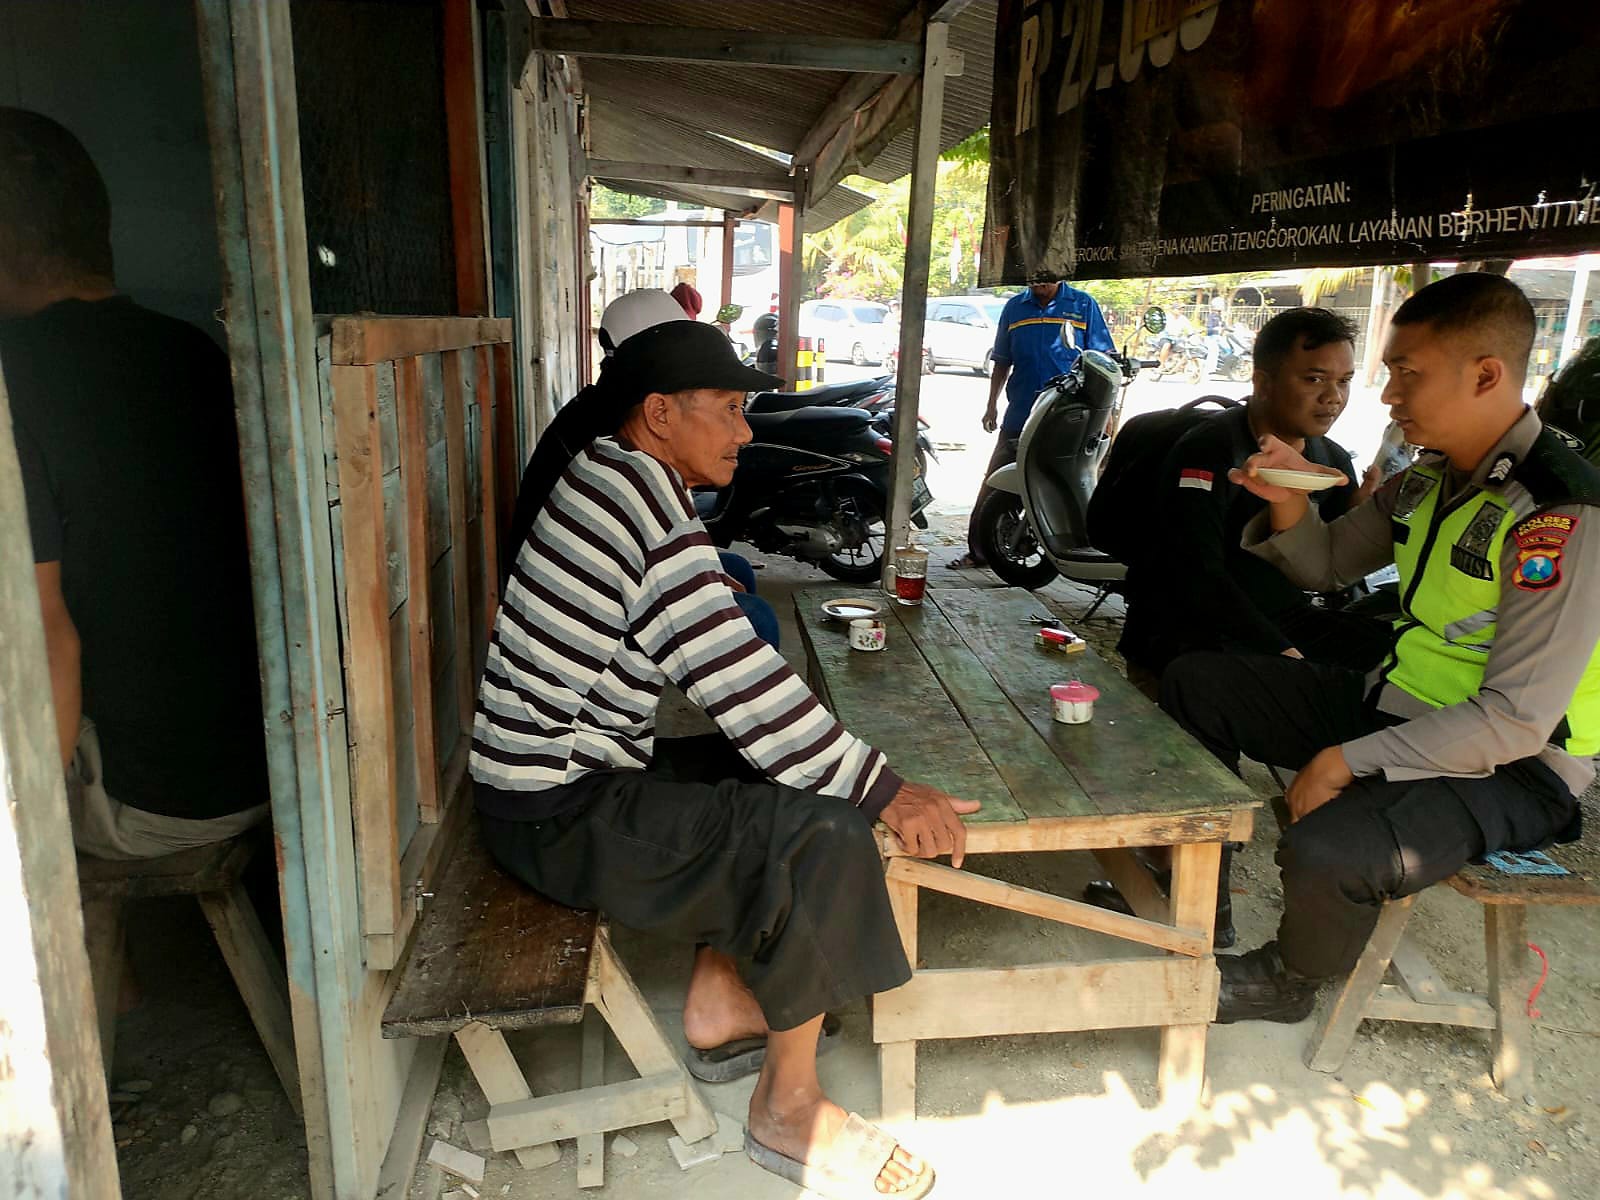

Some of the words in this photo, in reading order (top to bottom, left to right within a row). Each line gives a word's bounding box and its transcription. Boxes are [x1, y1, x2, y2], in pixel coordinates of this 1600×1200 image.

[1250, 181, 1351, 214] PERINGATAN:
[1180, 233, 1228, 255] KANKER
[1231, 224, 1344, 252] TENGGOROKAN.
[1349, 215, 1433, 243] LAYANAN
[1438, 203, 1560, 238] BERHENTI
